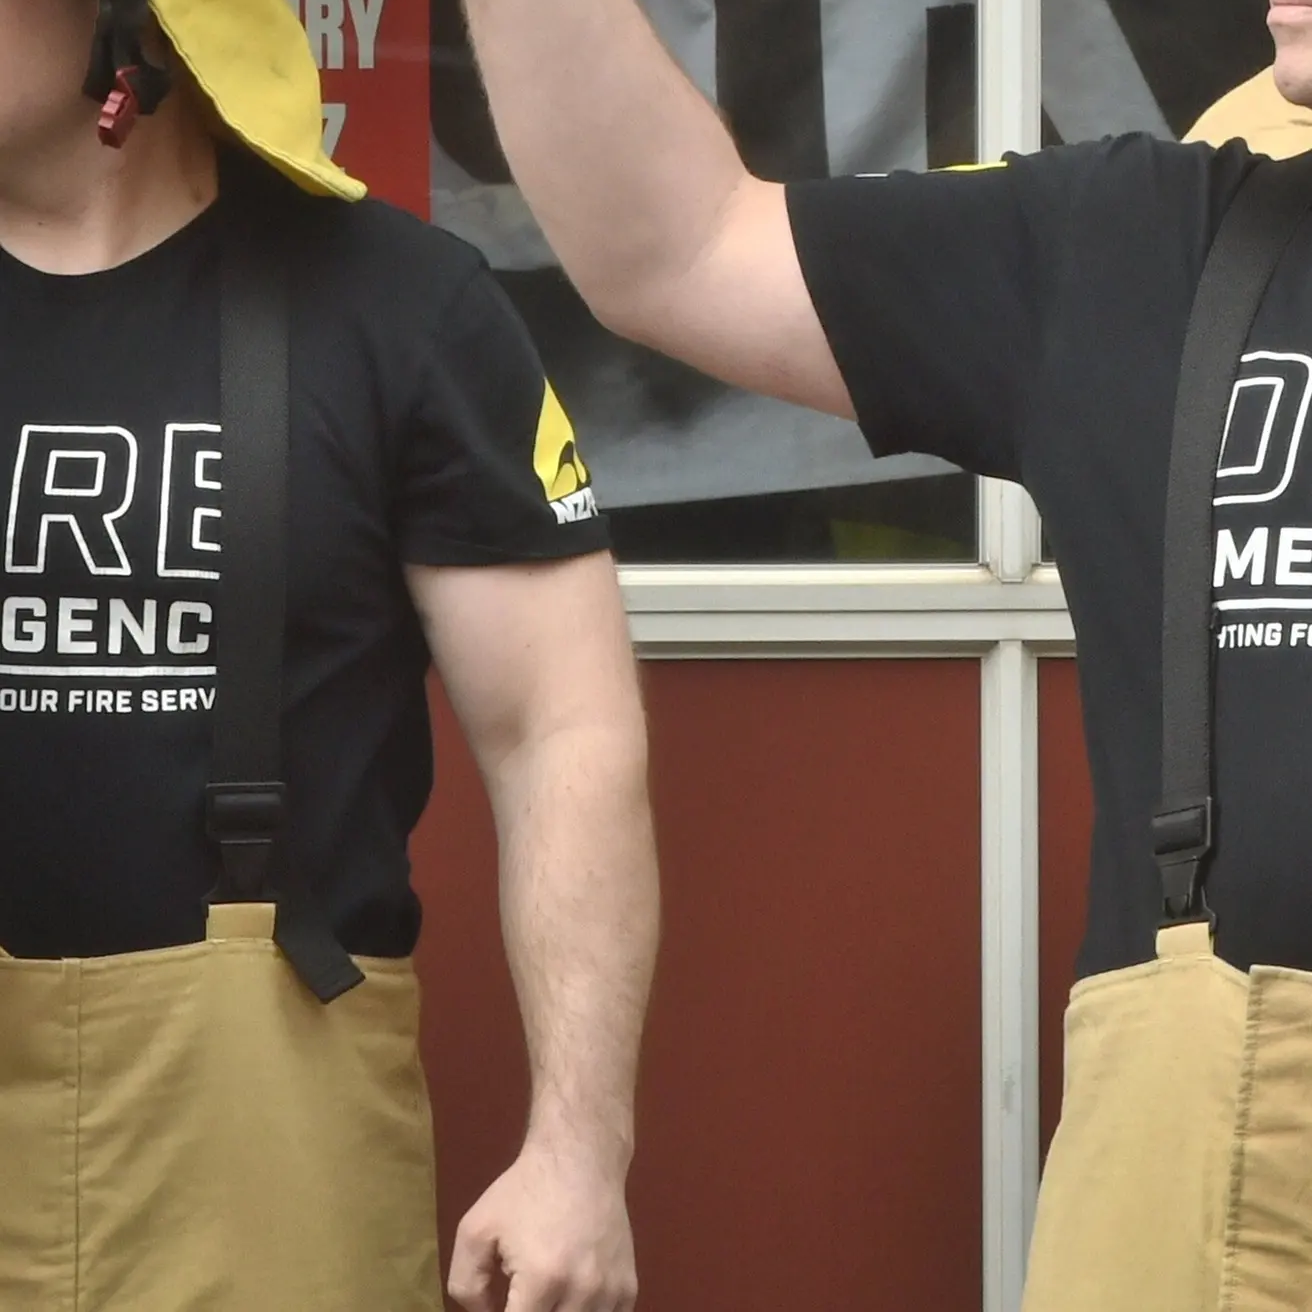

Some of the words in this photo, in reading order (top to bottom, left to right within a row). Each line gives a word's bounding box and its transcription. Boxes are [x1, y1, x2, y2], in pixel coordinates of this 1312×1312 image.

[2, 596, 213, 655] GENC
[0, 689, 58, 713] OUR
[68, 689, 132, 713] FIRE
[141, 688, 216, 713] SERV
